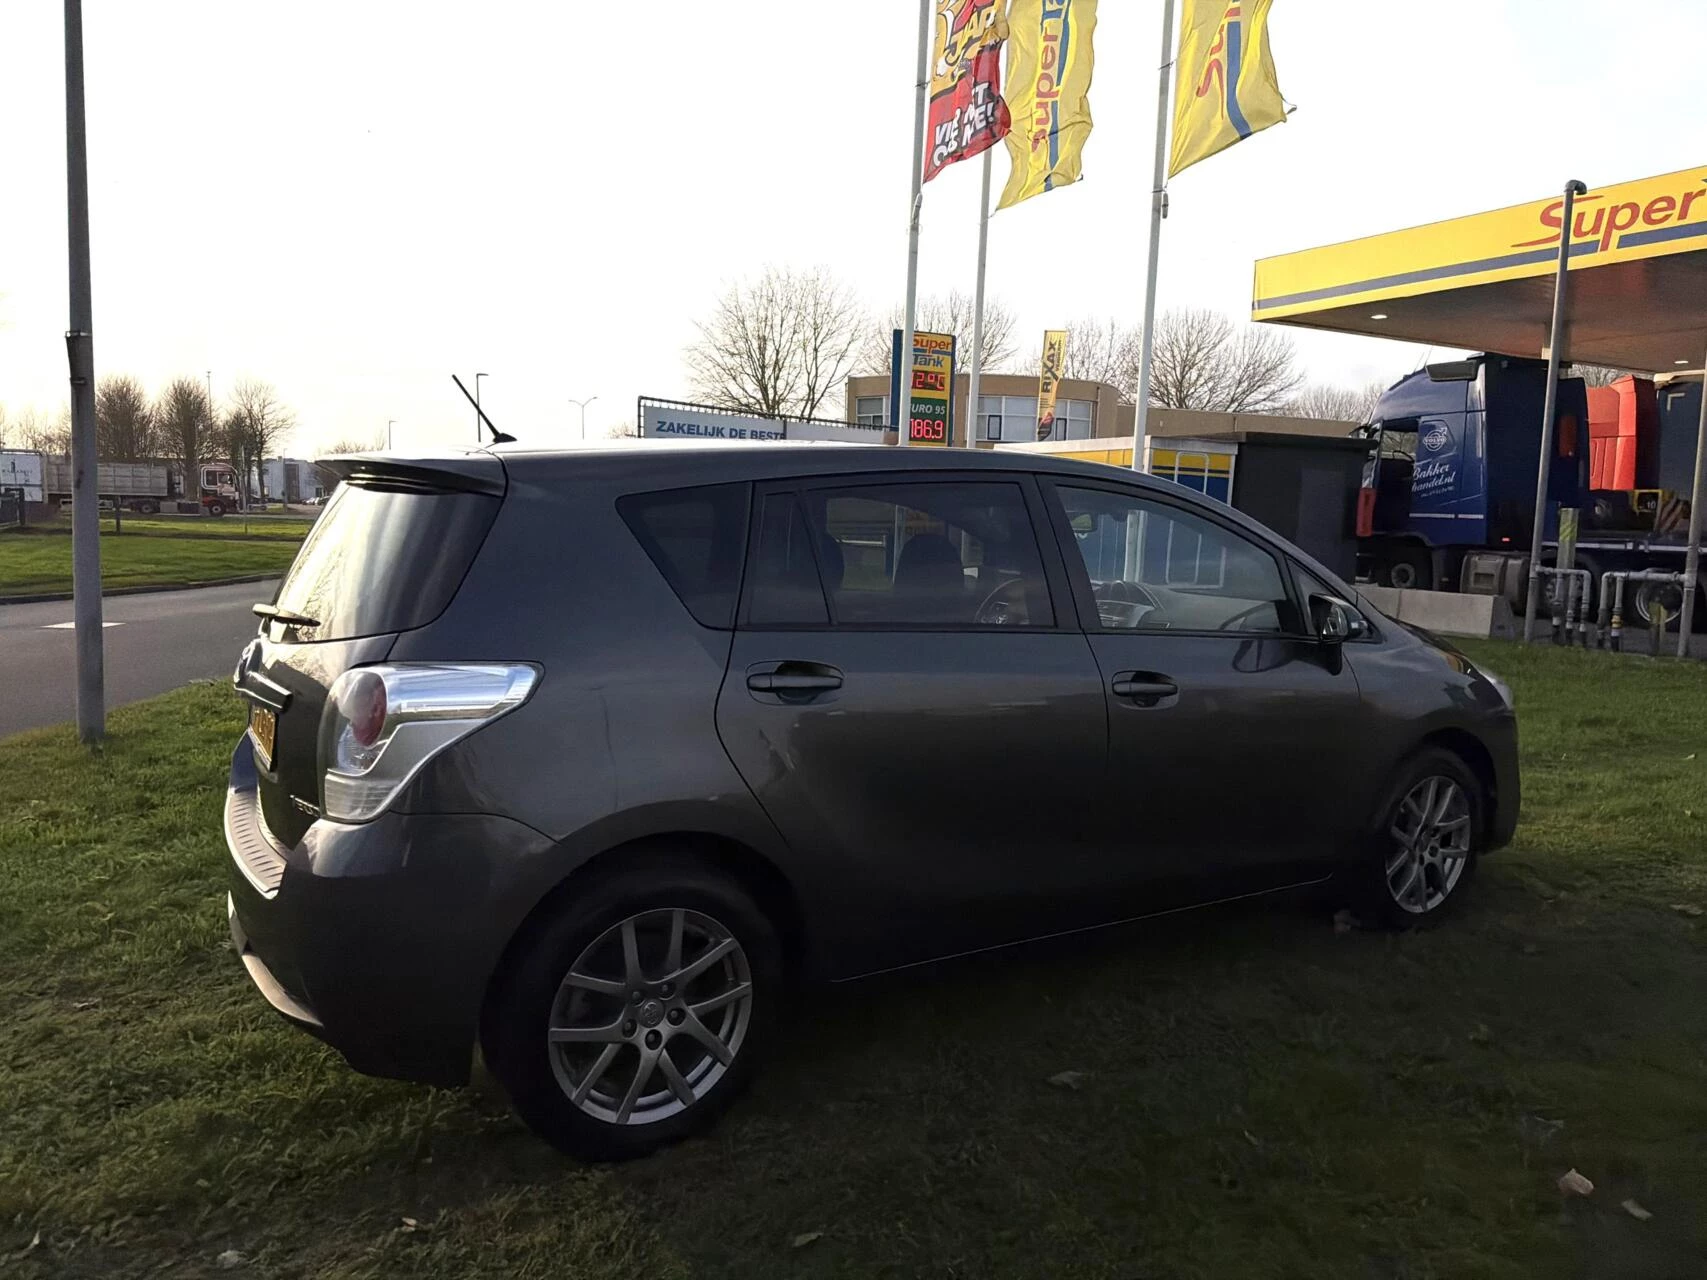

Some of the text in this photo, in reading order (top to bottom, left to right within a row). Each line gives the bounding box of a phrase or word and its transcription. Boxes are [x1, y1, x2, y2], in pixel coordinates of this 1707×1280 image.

[1511, 190, 1707, 253] Super
[912, 334, 953, 355] Super
[912, 353, 945, 367] Tank
[911, 403, 946, 415] URO 95
[656, 420, 726, 438] ZAKELIJK
[729, 428, 747, 439] DE
[1413, 463, 1450, 480] Bakker
